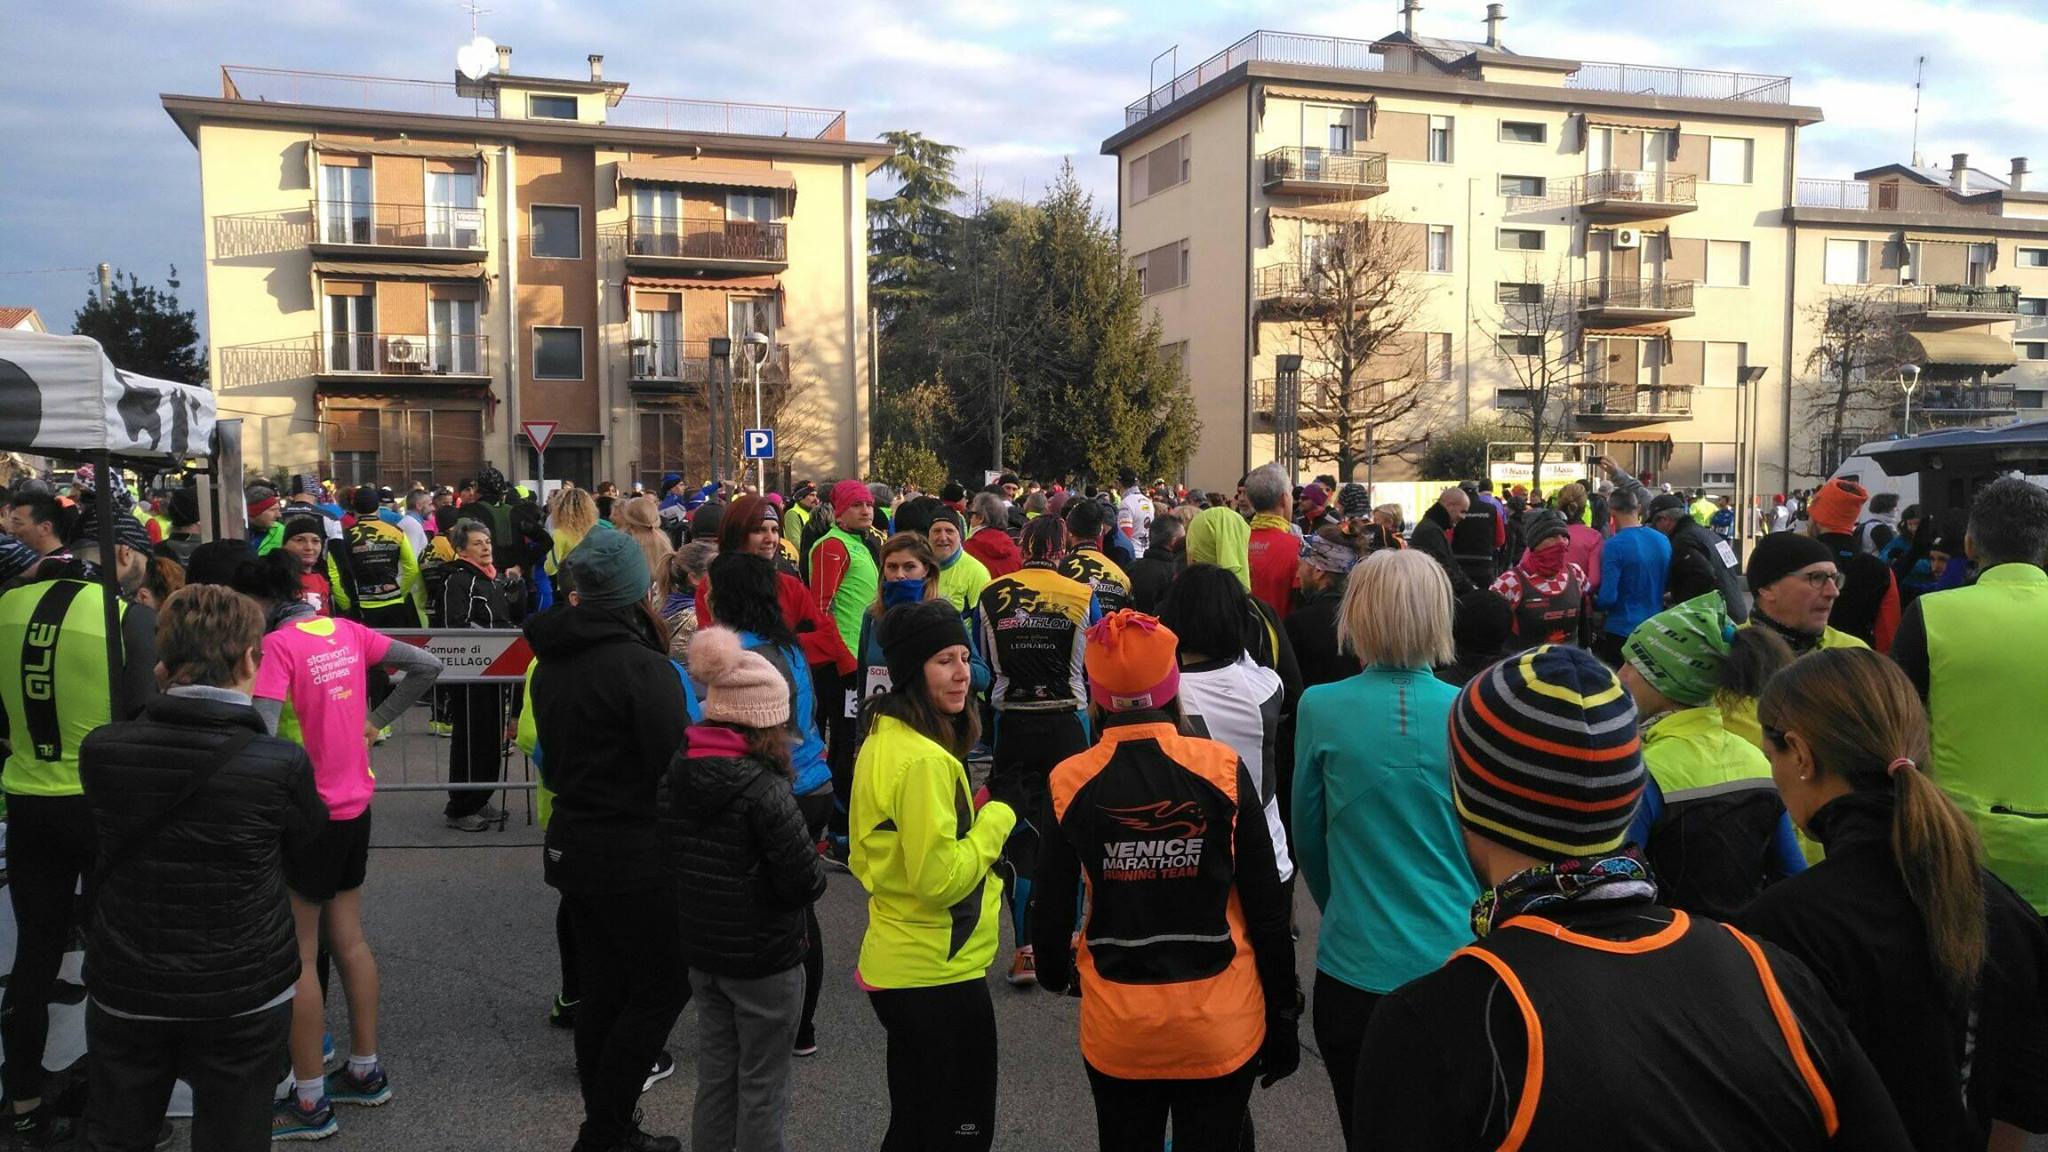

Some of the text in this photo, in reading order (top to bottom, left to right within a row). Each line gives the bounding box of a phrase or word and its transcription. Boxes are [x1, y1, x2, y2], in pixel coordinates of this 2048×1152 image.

[750, 432, 769, 456] P
[423, 645, 481, 654] Comune di
[1104, 838, 1204, 858] VENICE
[1103, 854, 1200, 870] MARATHON
[1103, 866, 1199, 881] RUNNING TEAM
